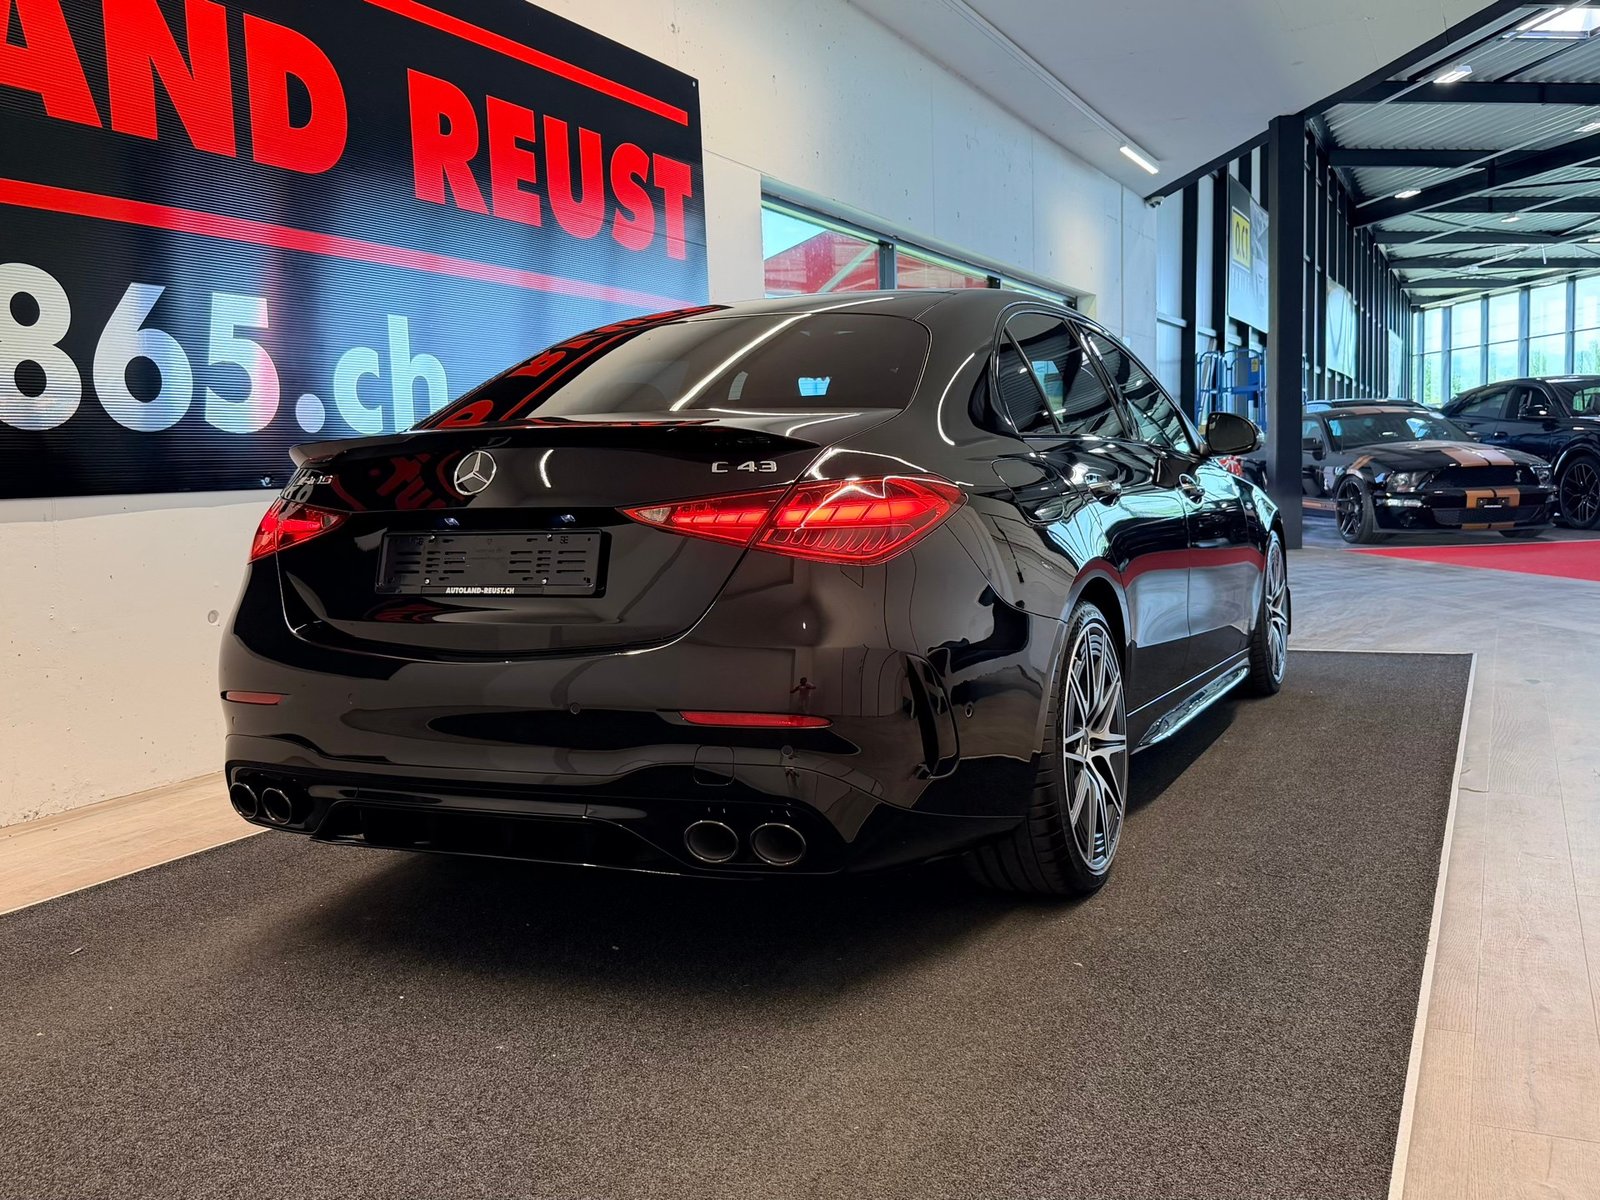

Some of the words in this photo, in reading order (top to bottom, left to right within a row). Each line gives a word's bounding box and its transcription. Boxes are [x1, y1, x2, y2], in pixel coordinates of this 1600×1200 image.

[406, 67, 693, 260] REUST
[0, 262, 449, 434] 865.ch
[711, 461, 729, 473] C
[736, 460, 778, 473] 43
[445, 586, 515, 594] AUTOLAND-REUST.CH
